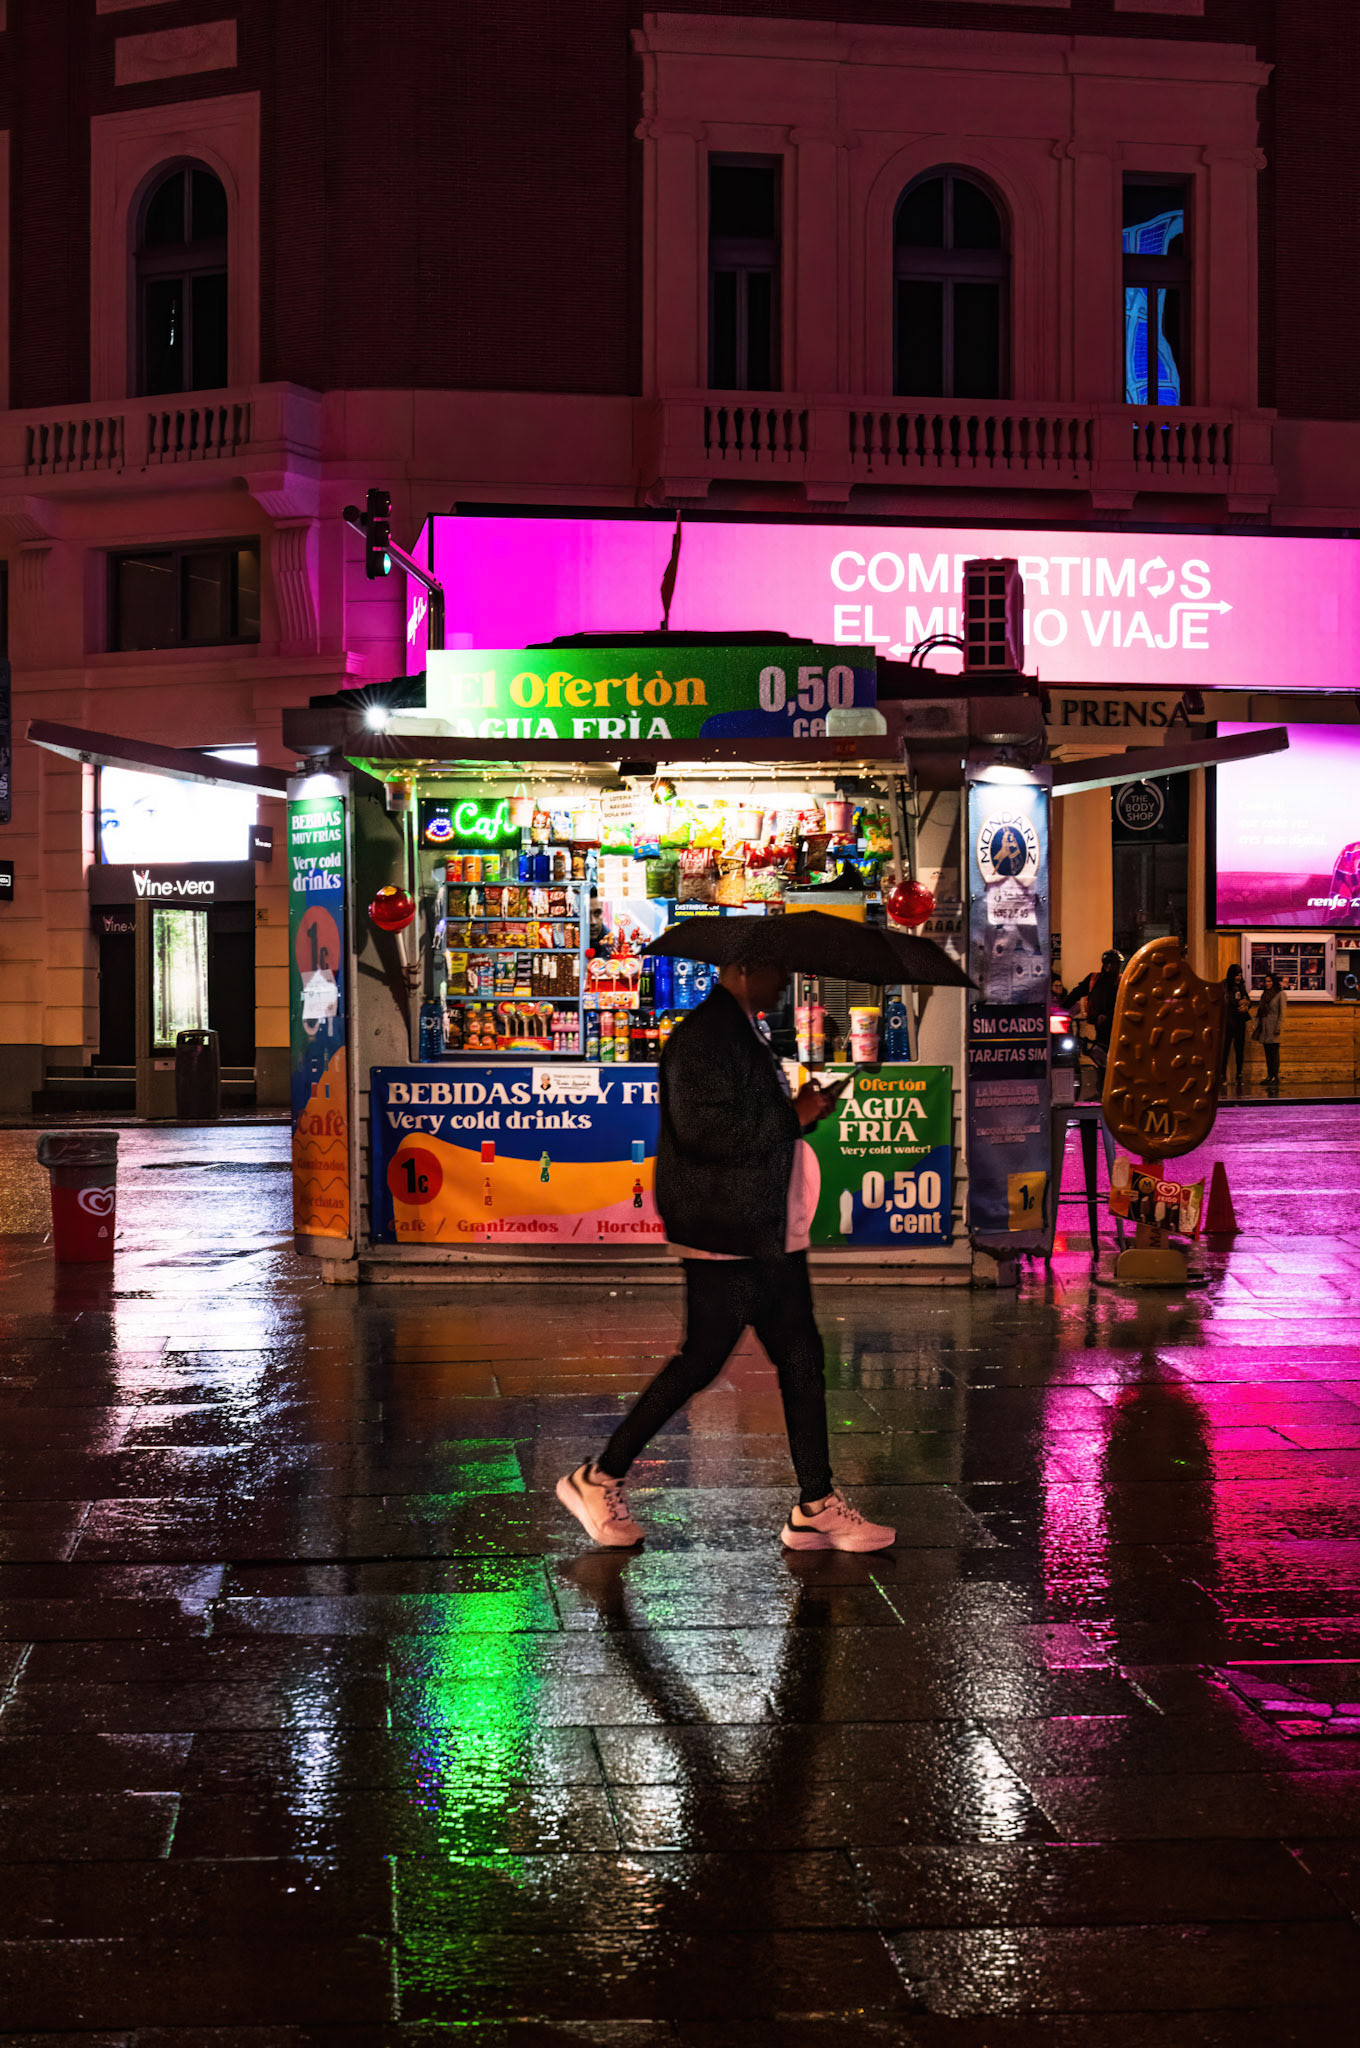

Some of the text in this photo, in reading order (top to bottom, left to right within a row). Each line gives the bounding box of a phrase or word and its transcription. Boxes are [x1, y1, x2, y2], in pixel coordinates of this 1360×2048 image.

[831, 551, 1211, 600] COMRTIMOS
[834, 602, 1210, 649] EL MIO VIAJE
[454, 669, 498, 709] El
[758, 665, 855, 717] 0,50
[1061, 699, 1192, 728] PRENSA
[455, 716, 560, 739] AGUA
[792, 717, 827, 738] ce
[1125, 802, 1155, 813] BODY
[1131, 794, 1148, 803] THE
[292, 811, 342, 830] BEBIDAS
[1126, 812, 1154, 822] SHOP
[292, 831, 312, 845] MUY
[980, 811, 1037, 865] MONDARIZ
[292, 851, 342, 877] Very cold
[293, 870, 342, 892] drinks
[1307, 894, 1348, 911] renfe
[973, 1017, 1045, 1034] SIM CARDS
[968, 1047, 1048, 1063] TARJETAS SIM
[386, 1082, 532, 1105] BEBIDAS
[839, 1097, 929, 1119] AGUA
[386, 1109, 593, 1135] Very cold drinks
[1144, 1110, 1170, 1135] M
[840, 1145, 932, 1157] Very cold water!
[862, 1170, 942, 1213] 0,50
[457, 1218, 559, 1233] Granizados
[597, 1218, 664, 1233] Horcha
[890, 1211, 942, 1234] cent
